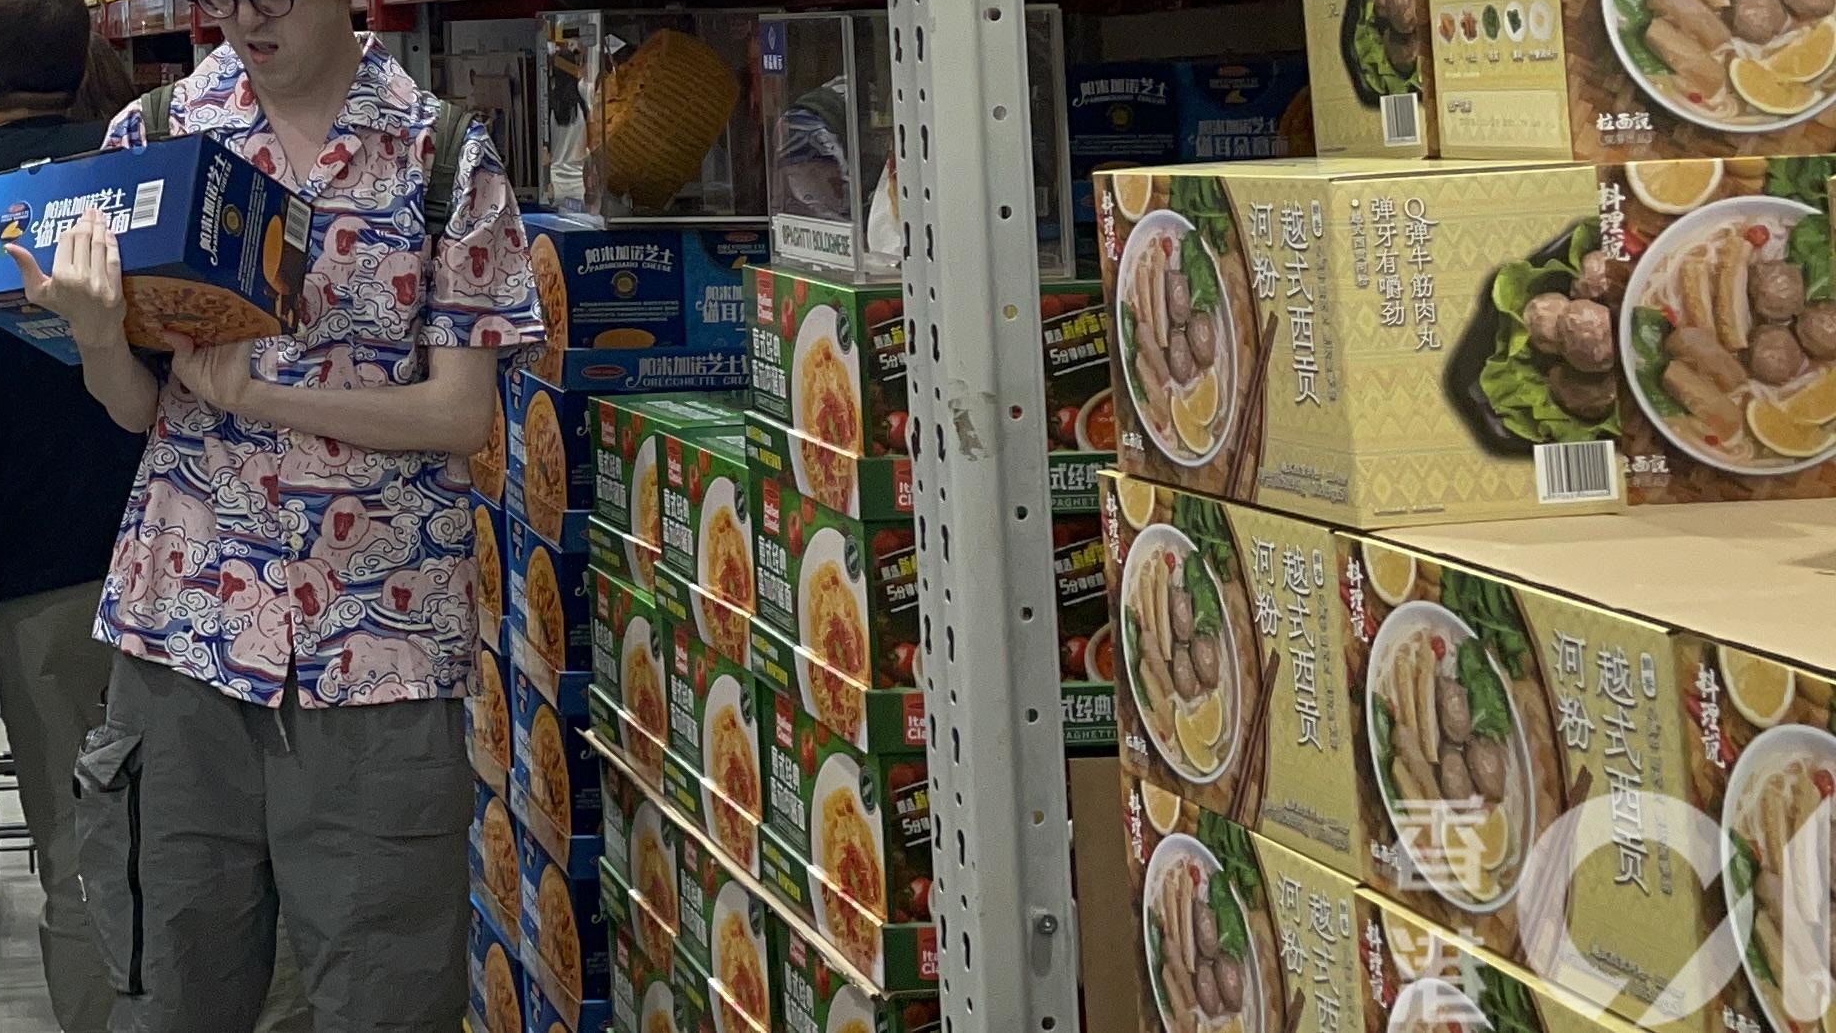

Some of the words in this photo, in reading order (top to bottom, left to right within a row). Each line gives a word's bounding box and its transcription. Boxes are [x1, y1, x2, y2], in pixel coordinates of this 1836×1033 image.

[1249, 201, 1282, 299] 河粉
[1280, 200, 1322, 408] 越式西贡
[1371, 197, 1406, 326] 弹牙有嚼劲
[1404, 197, 1441, 351] Q弹牛筋肉丸
[1250, 535, 1283, 637] 河粉
[1282, 543, 1324, 752] 越式西贡
[1551, 628, 1597, 750] 河粉
[1595, 643, 1652, 897] 越式西贡
[1276, 871, 1309, 977] 河粉
